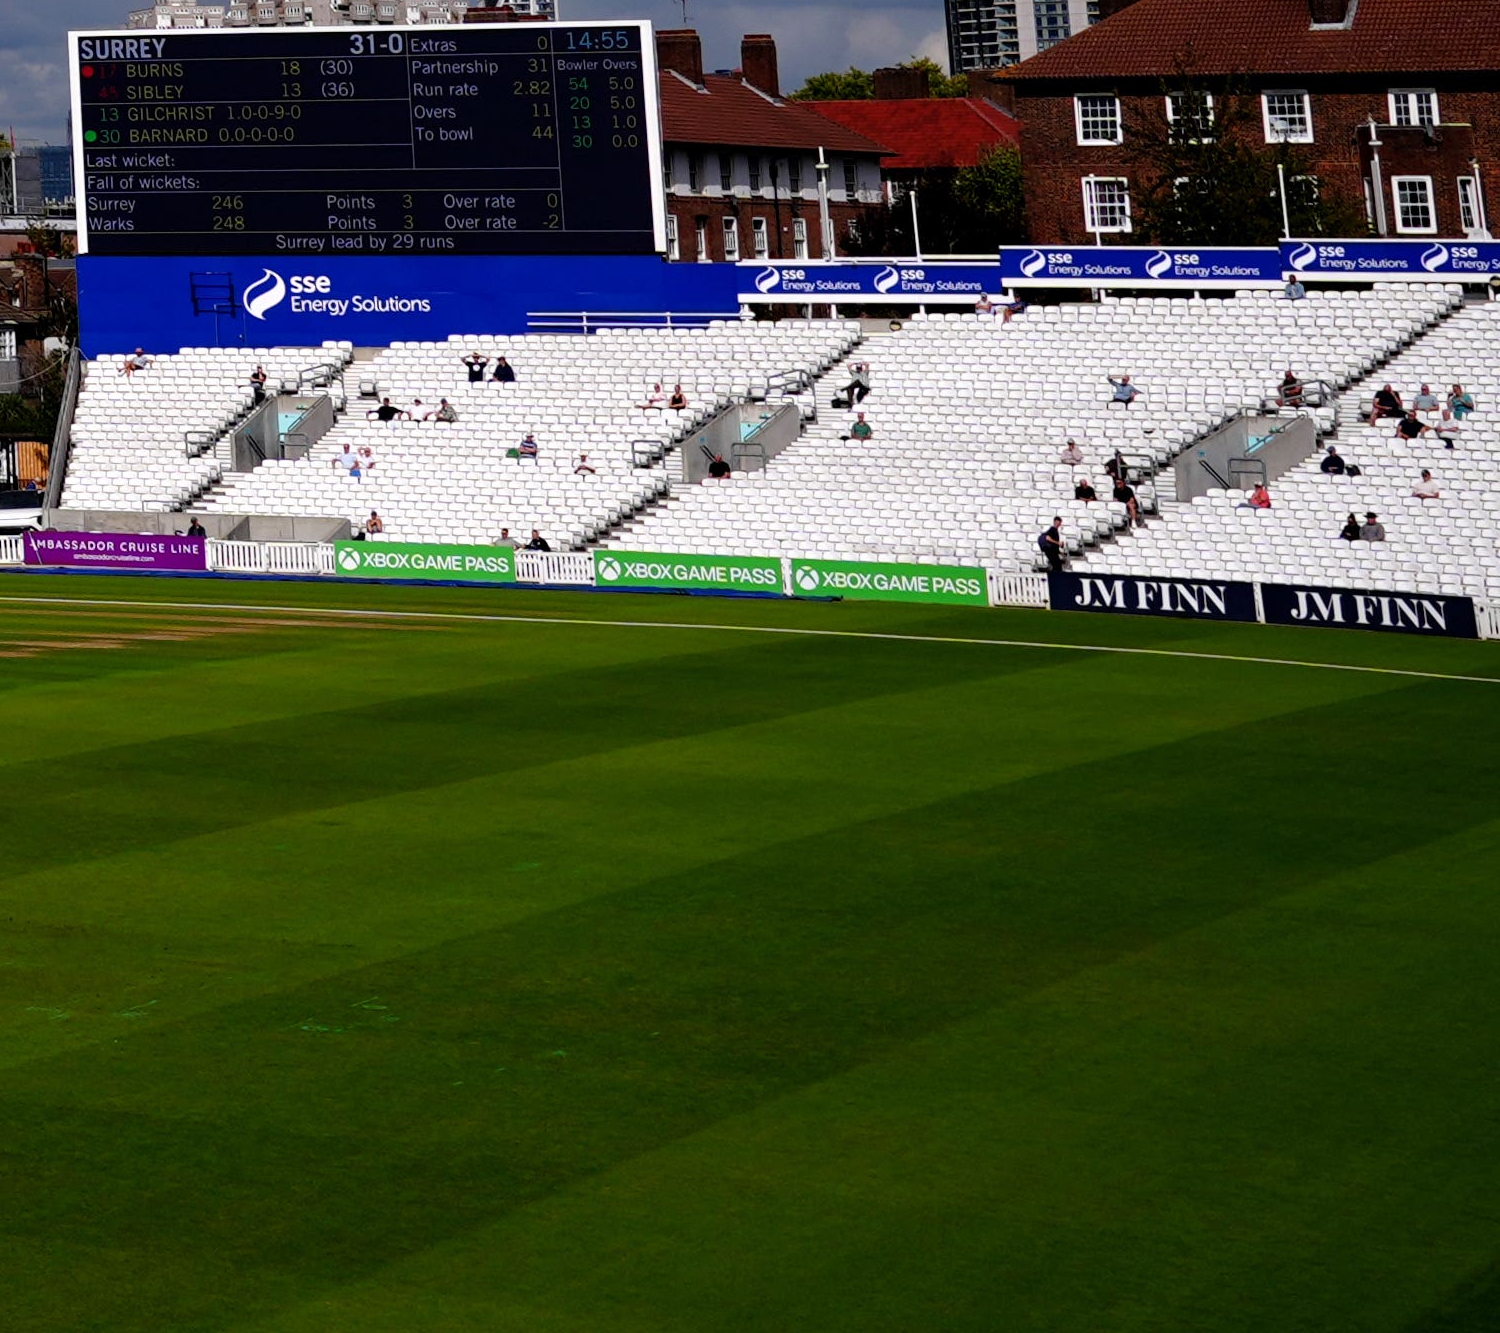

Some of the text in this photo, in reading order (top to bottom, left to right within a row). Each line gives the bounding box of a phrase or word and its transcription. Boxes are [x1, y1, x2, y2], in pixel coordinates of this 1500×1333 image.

[81, 34, 403, 60] SURREY 31-0
[411, 37, 548, 52] Extras 0
[567, 32, 629, 50] 14:55
[126, 64, 184, 78] BURNS
[281, 61, 300, 75] 18
[320, 60, 353, 76] (30)
[412, 59, 547, 76] Partnership 31
[557, 59, 637, 71] Bowler Overs
[126, 85, 184, 100] SIBLEY
[282, 84, 301, 97] 13
[321, 82, 355, 98] (36)
[414, 82, 551, 96] Run rate 2.82
[568, 77, 634, 90] 54 5.0
[570, 96, 635, 110] 20 5.0
[100, 105, 301, 121] 13 GILCHRIST 1.0-0-9-0
[414, 104, 551, 119] Overs 11
[572, 116, 636, 129] 13 1.0
[99, 128, 294, 143] 30 BARNARD 0.0-0-0-0
[415, 126, 553, 141] To bowl 44
[572, 135, 638, 148] 30 0.0
[87, 153, 175, 168] Last wicket:
[88, 175, 200, 190] Fall of wickets:
[88, 194, 558, 213] Surrey 246 Points 3 Over rate 0
[89, 215, 559, 231] Warks 248 Points 3 Over rate -2
[275, 235, 454, 252] Surrey lead by 29 runs
[1319, 246, 1345, 257] sse
[1319, 258, 1408, 271] Energy Solutions
[290, 276, 331, 294] sse
[291, 295, 431, 316] Energy Solutions
[120, 541, 165, 554] CRUISE
[171, 543, 199, 554] LINE
[363, 553, 510, 573] XBOX GAME PASS
[1075, 578, 1226, 614] JM FINN
